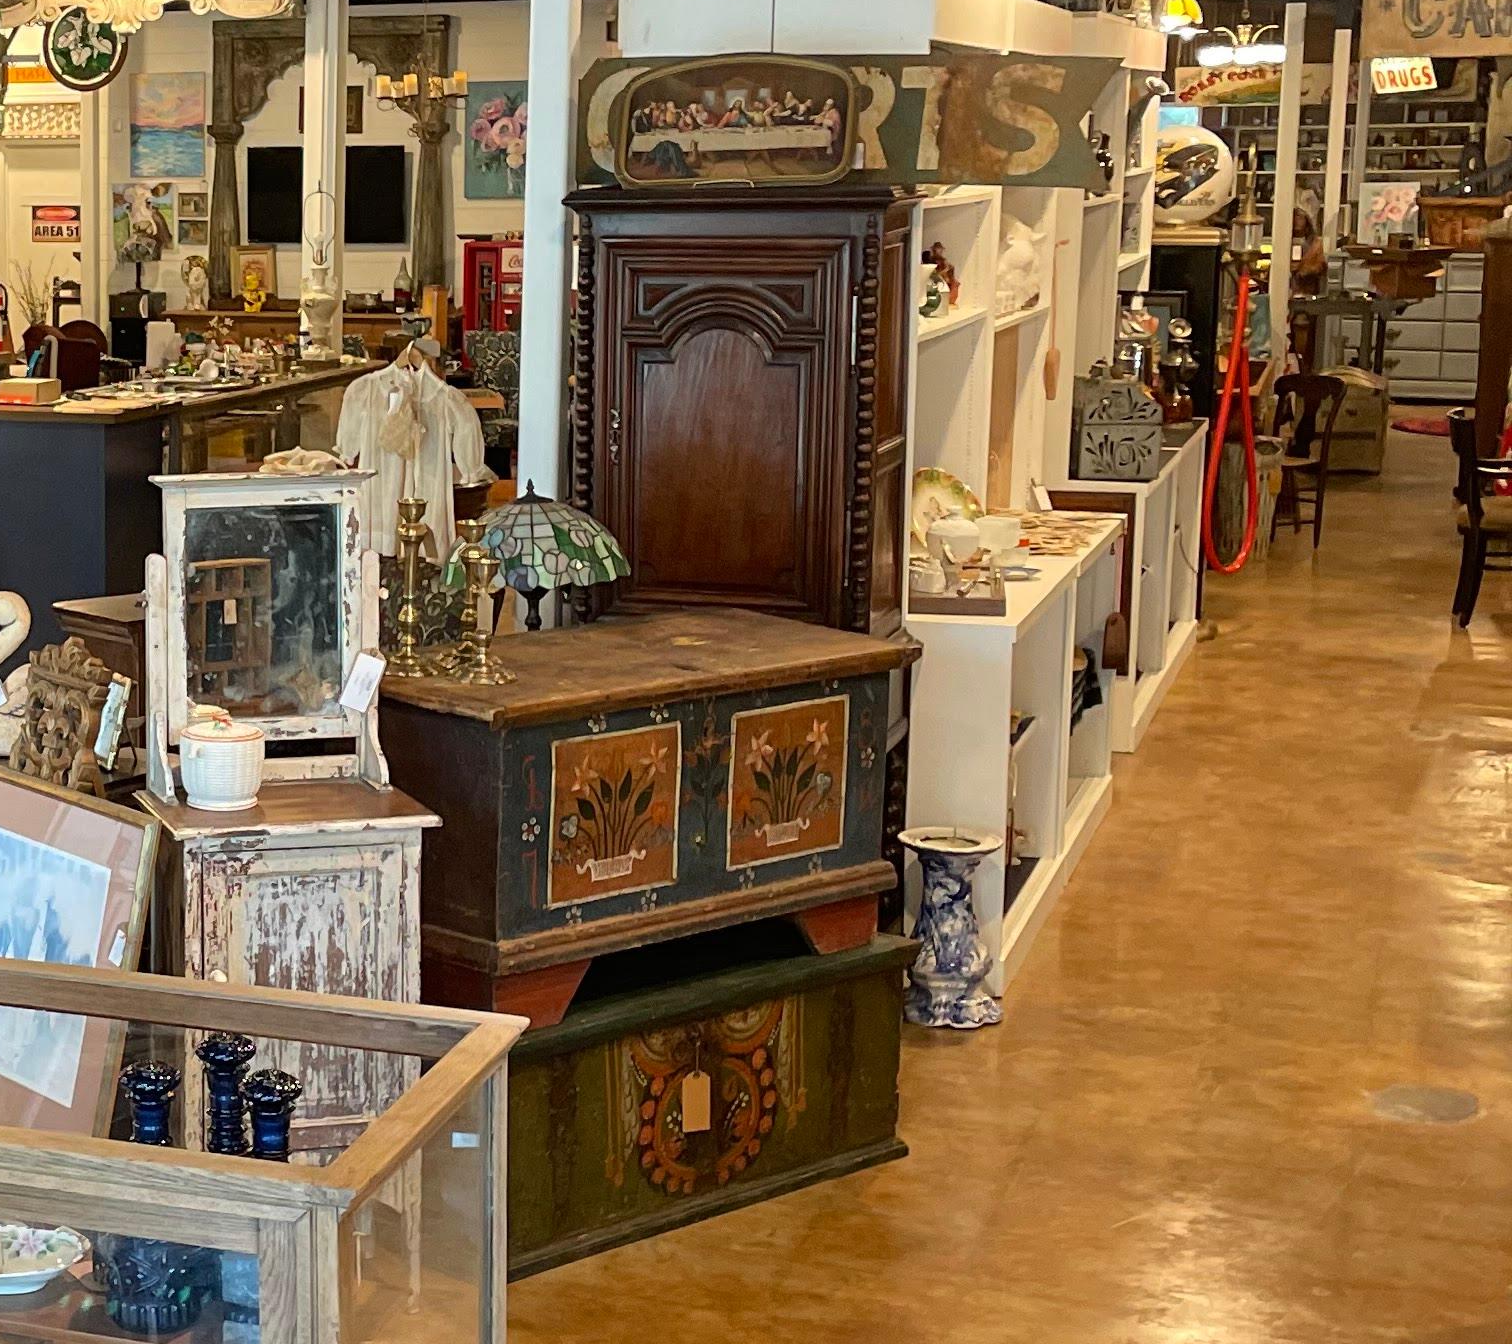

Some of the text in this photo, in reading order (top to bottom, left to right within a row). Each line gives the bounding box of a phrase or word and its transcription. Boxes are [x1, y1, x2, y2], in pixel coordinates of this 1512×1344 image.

[1375, 65, 1433, 90] DRUGS
[34, 224, 80, 238] AREA 51
